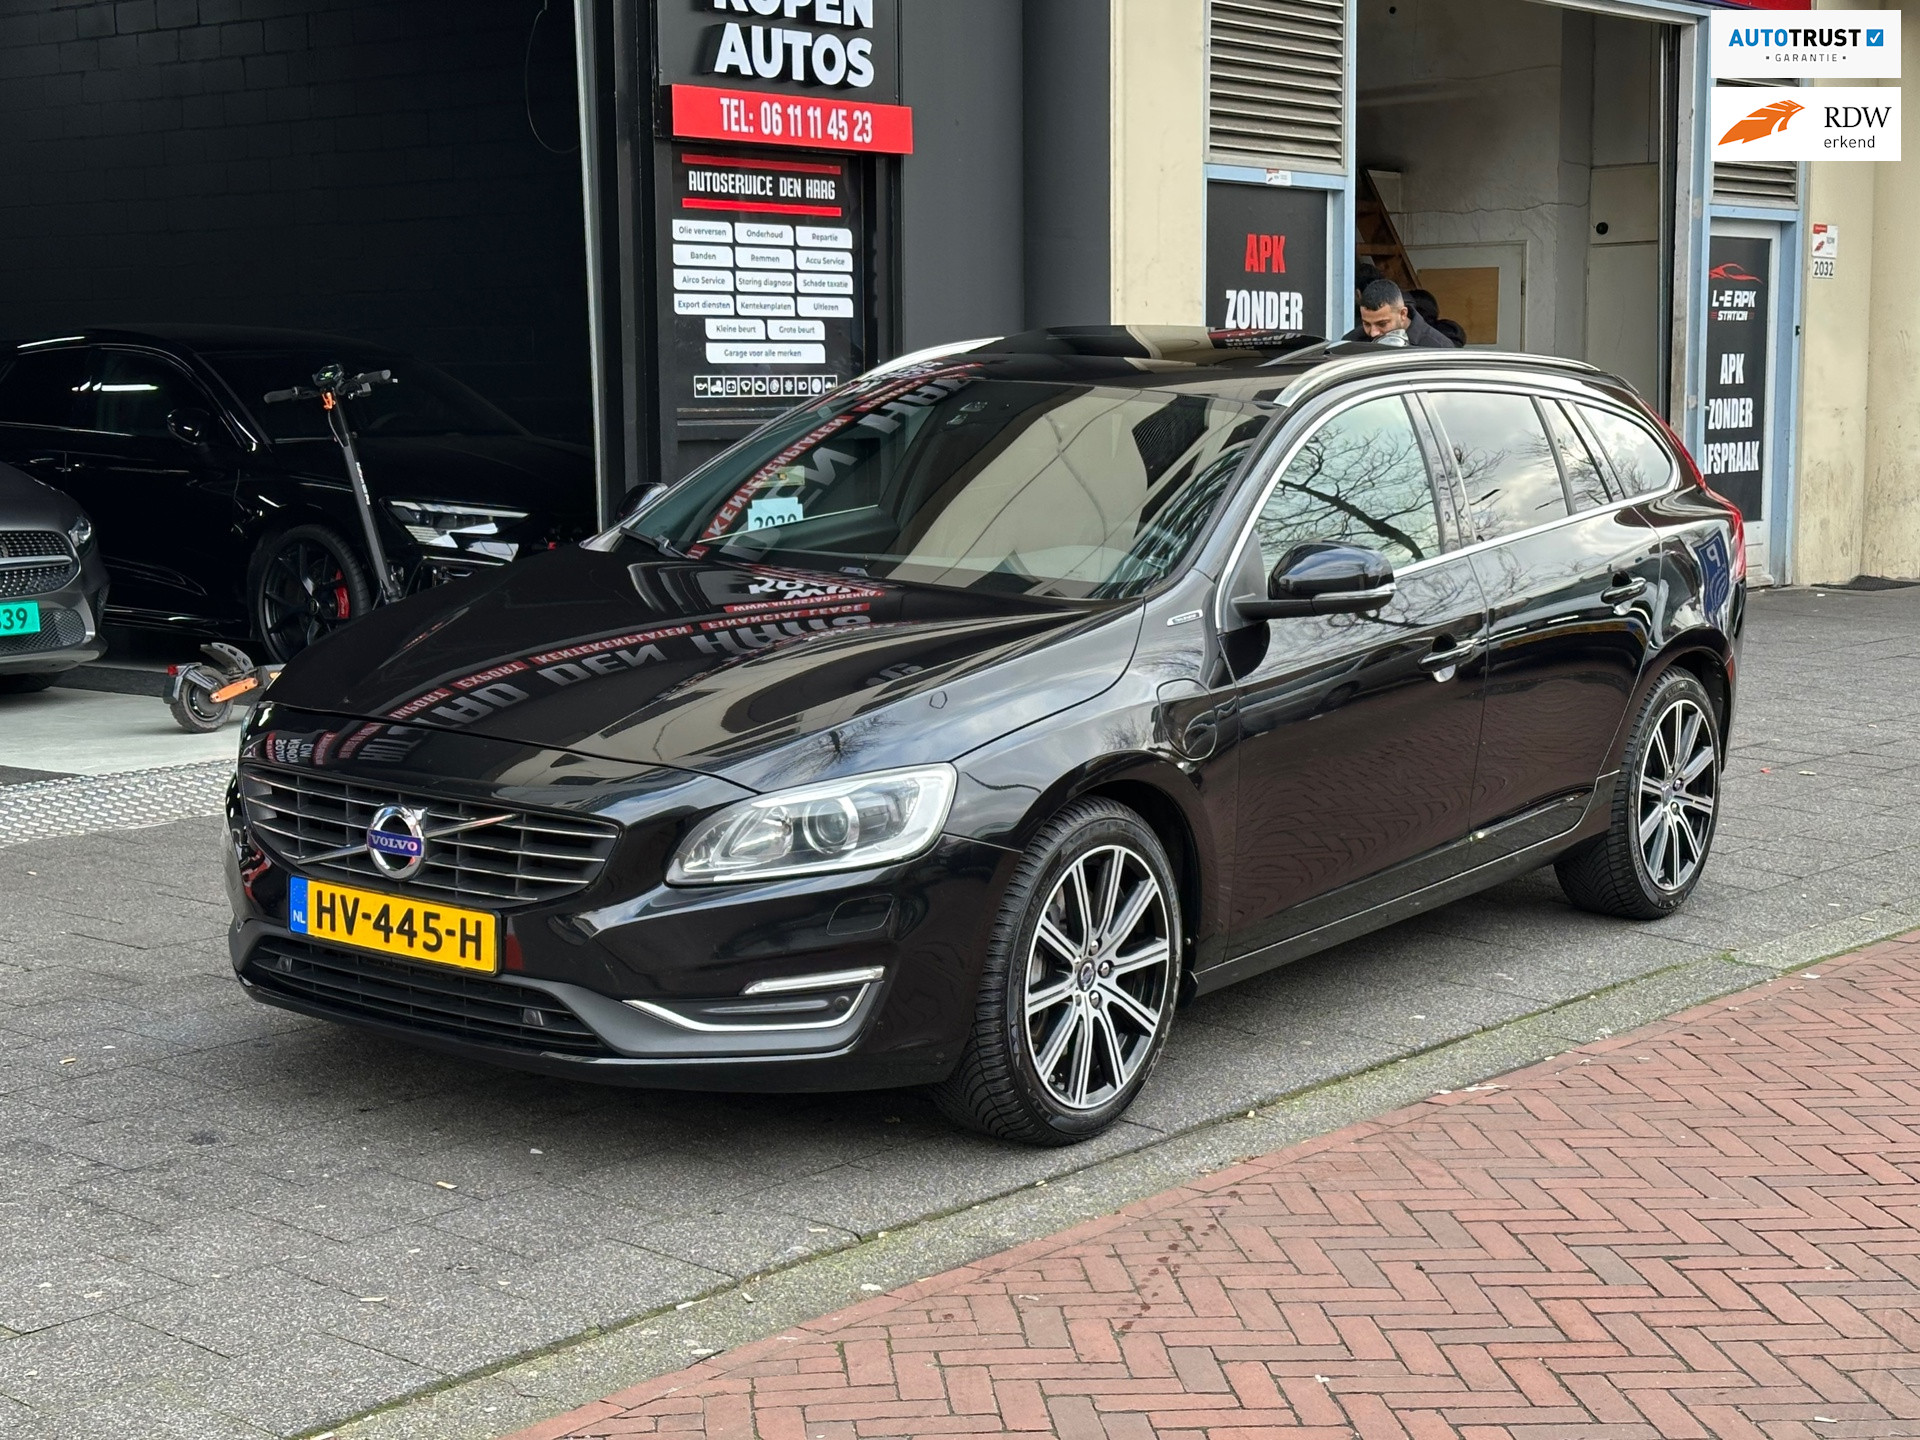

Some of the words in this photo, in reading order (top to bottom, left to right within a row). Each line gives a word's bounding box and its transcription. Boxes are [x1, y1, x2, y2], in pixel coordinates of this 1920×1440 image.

[714, 22, 874, 88] AUTOS
[720, 97, 754, 133] TEL:
[760, 101, 783, 136] 06
[787, 105, 802, 137] 11
[807, 106, 822, 139] 11
[827, 108, 849, 141] 45
[853, 110, 873, 144] 23
[688, 170, 773, 197] AUTOSERVICE
[779, 177, 802, 199] DEN
[805, 178, 836, 200] HAAG
[678, 226, 692, 235] Olie
[693, 227, 727, 237] verversen
[746, 229, 784, 239] Onderhoud
[690, 251, 717, 261] Banden
[750, 254, 780, 263] Remmen
[1244, 234, 1286, 274] APK
[805, 256, 821, 265] Accu
[822, 257, 845, 266] Service
[1814, 260, 1834, 276] 2032
[682, 275, 700, 285] Airco
[701, 276, 726, 285] Service
[738, 277, 763, 288] Storing
[763, 278, 793, 289] diagnose
[803, 279, 826, 288] Schade
[827, 280, 848, 288] taxatie
[677, 300, 700, 311] Export
[701, 301, 731, 310] diensten
[740, 302, 792, 312] Kentekenplaten
[1225, 290, 1304, 331] ZONDER
[1717, 310, 1748, 321] STATION
[716, 325, 737, 333] Kleine
[738, 325, 756, 334] beurt
[779, 325, 797, 334] Grote
[797, 326, 816, 335] beurt
[723, 349, 749, 359] Garage
[749, 350, 764, 358] voor
[764, 349, 776, 358] alle
[776, 349, 802, 358] merken
[1720, 353, 1745, 385] APK
[1708, 397, 1753, 430] ZONDER
[370, 833, 418, 852] VOLVO
[293, 910, 306, 925] NL
[316, 890, 482, 962] HV-445-H
